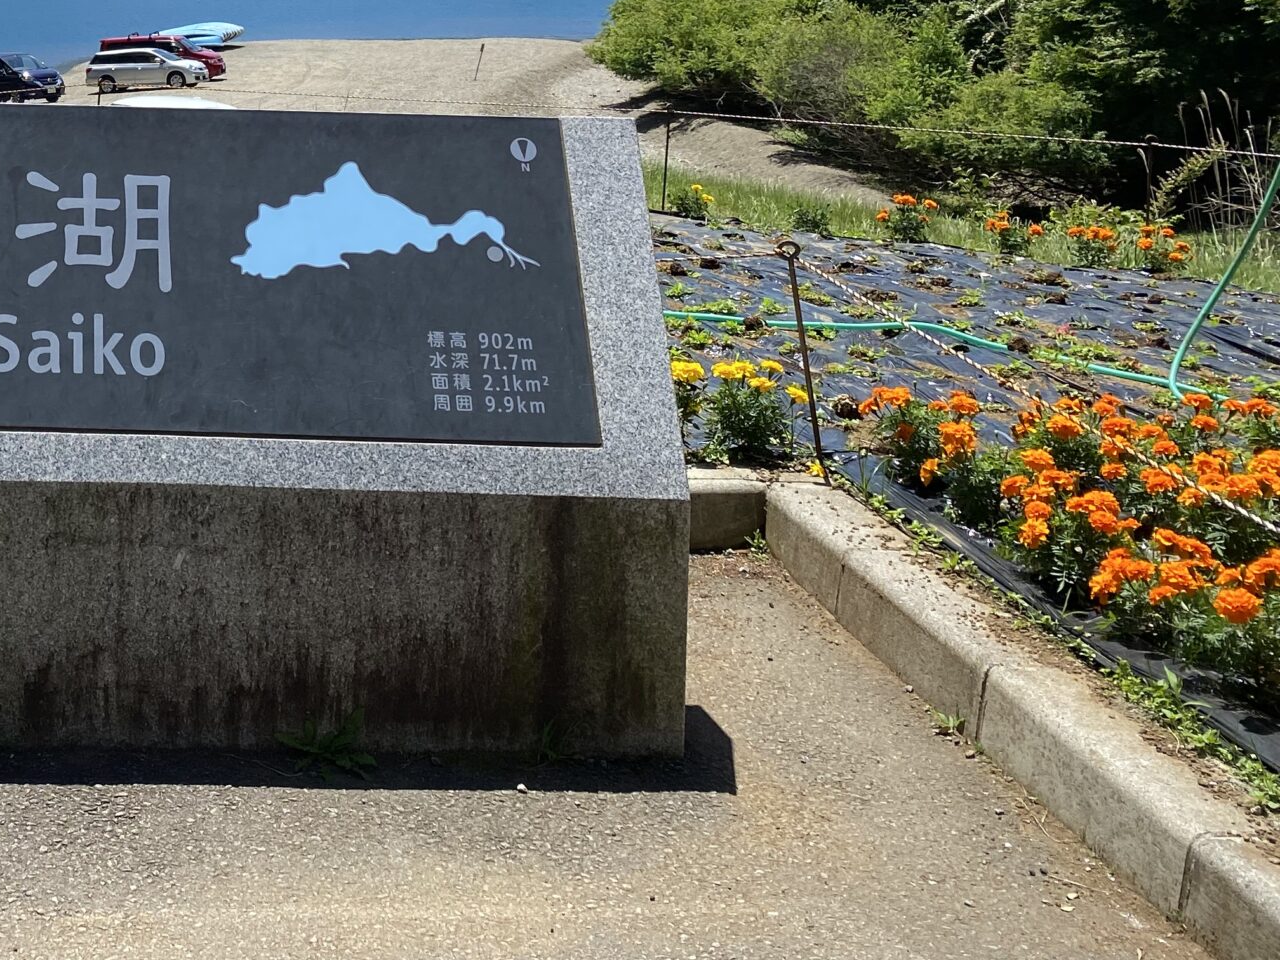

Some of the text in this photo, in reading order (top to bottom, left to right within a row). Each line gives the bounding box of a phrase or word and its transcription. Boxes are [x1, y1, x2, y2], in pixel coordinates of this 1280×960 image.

[520, 162, 531, 172] N
[427, 330, 533, 350] 標高 902m
[429, 351, 537, 371] 水深 71.7m
[430, 372, 472, 391] 面積
[433, 393, 546, 414] 周囲 9.9km
